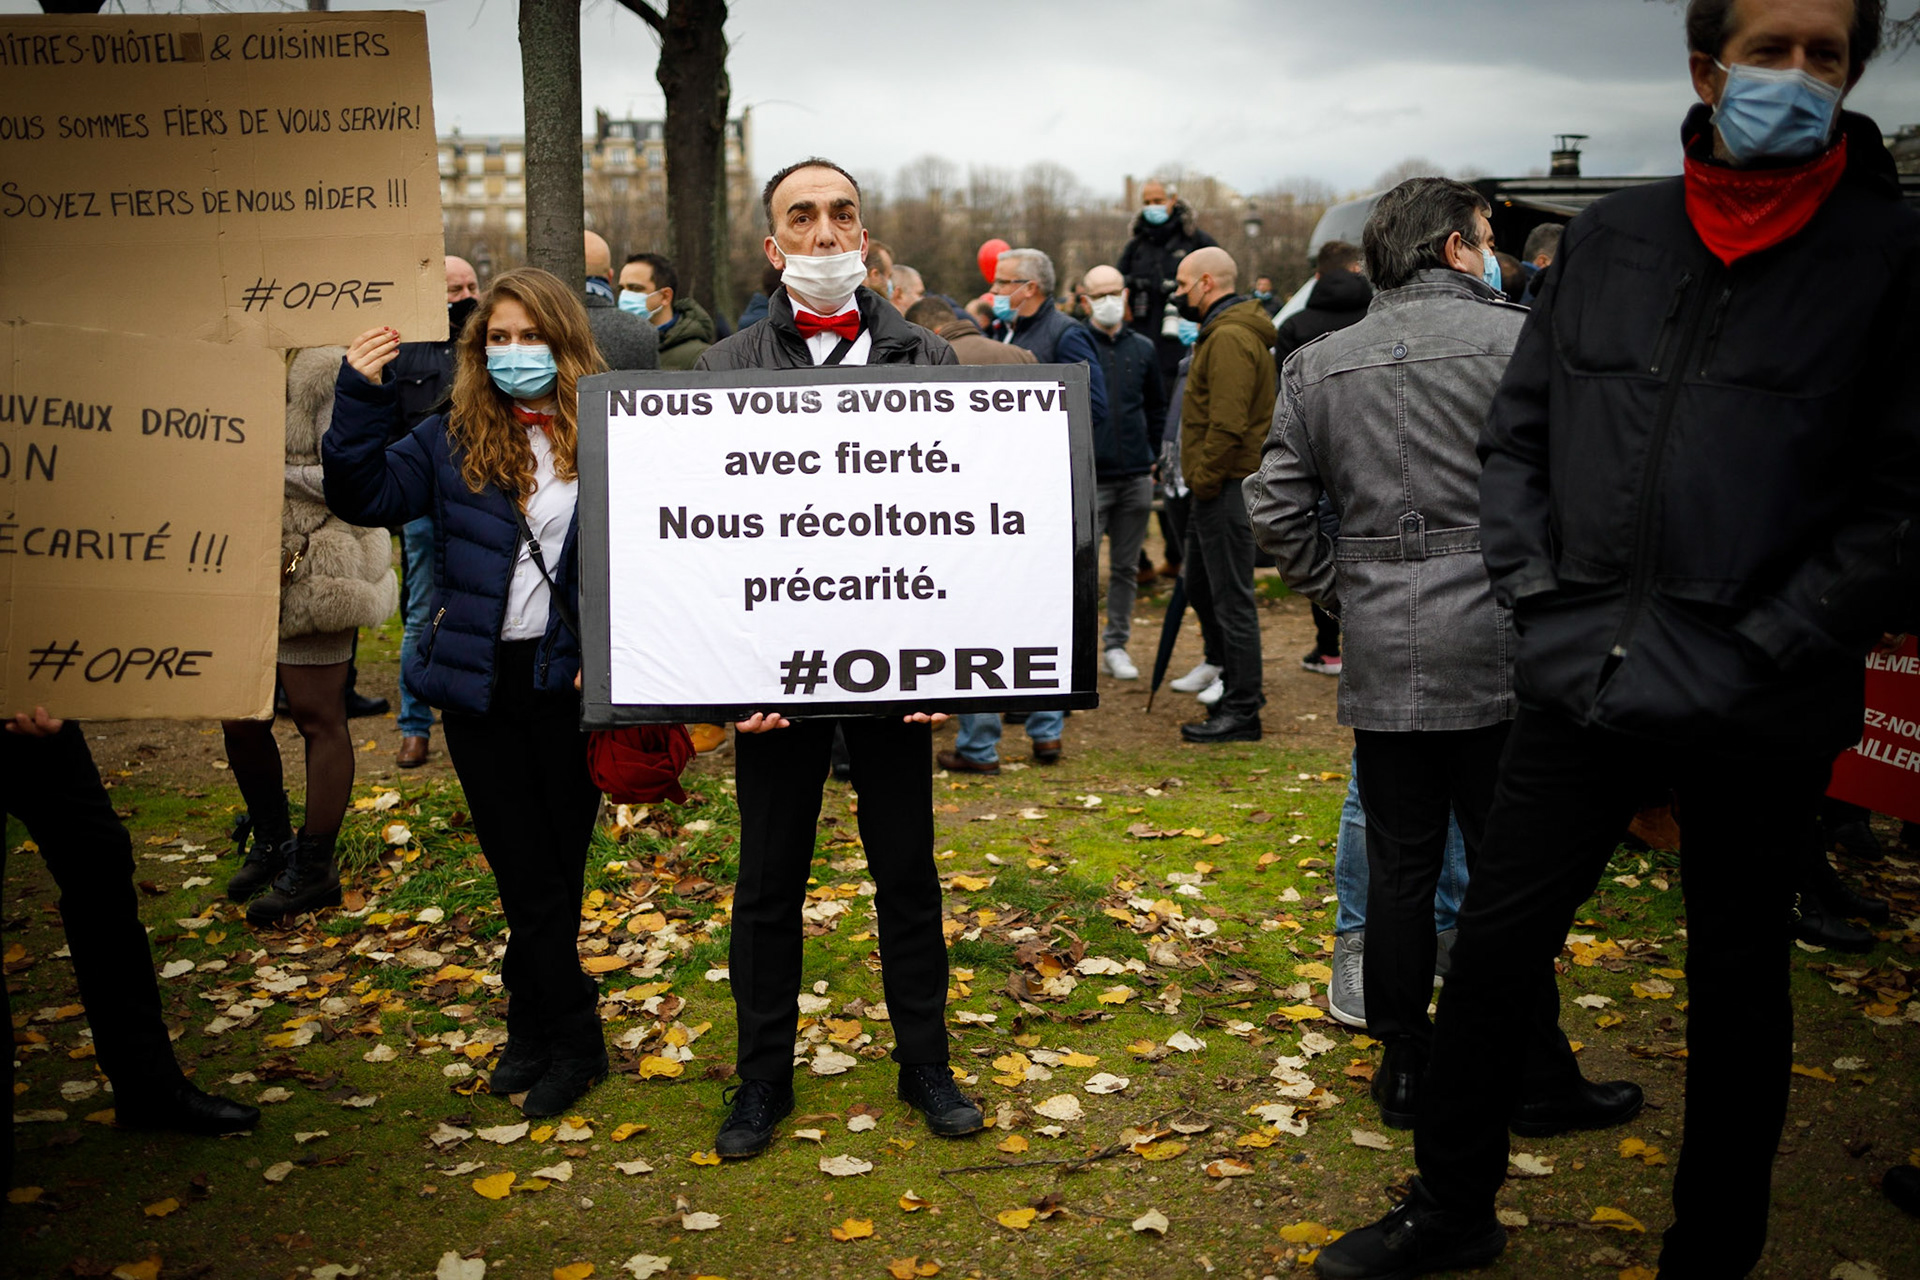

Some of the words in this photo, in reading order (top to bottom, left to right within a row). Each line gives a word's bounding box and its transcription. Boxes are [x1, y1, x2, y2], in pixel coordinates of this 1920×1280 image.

[210, 34, 232, 60] &
[0, 115, 45, 140] OUS
[58, 113, 149, 139] SOMMES
[164, 104, 228, 137] FIERS
[239, 108, 269, 135] DE
[277, 107, 331, 135] VOUS
[2, 181, 101, 220] SOYEZ
[111, 190, 194, 217] FIERS
[203, 190, 231, 214] DE
[236, 190, 296, 213] NOUS
[305, 180, 377, 211] AIDER
[388, 178, 408, 208] !!!
[242, 277, 394, 312] #OPRE
[609, 389, 713, 417] Nous
[727, 389, 822, 415] vous
[837, 388, 955, 413] avons
[969, 381, 1068, 412] servi
[142, 408, 246, 444] DROITS
[724, 449, 822, 475] avec
[834, 440, 961, 473] fierté.
[659, 506, 764, 539] Nous
[779, 503, 975, 537] récoltons
[990, 502, 1026, 535] la
[0, 512, 172, 561] ÉCARITÉ
[187, 530, 229, 573] !!!
[744, 565, 947, 611] précarité.
[28, 639, 213, 683] #OPRE
[780, 646, 1060, 695] #OPRE
[1865, 651, 1920, 676] NEME
